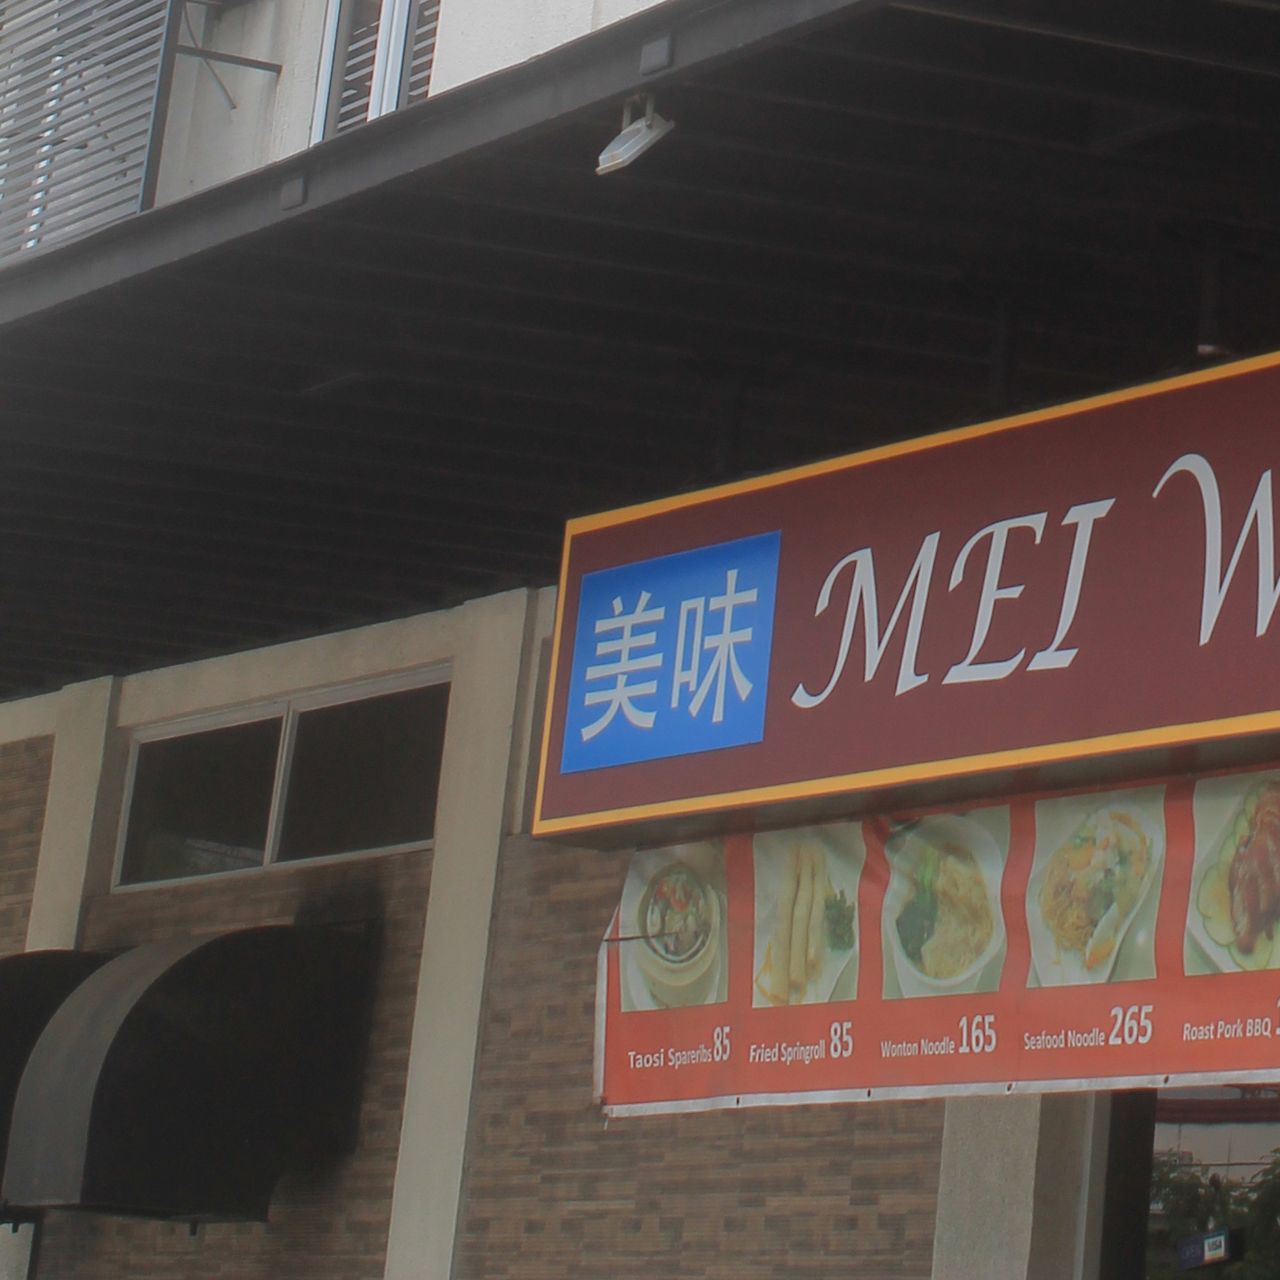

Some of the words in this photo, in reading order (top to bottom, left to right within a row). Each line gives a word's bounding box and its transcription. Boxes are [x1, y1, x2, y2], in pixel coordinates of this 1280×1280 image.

[791, 497, 1116, 710] MEI
[580, 568, 759, 742] 美味
[628, 1048, 664, 1069] Taosi
[667, 1044, 712, 1069] Spareribs
[713, 1026, 731, 1062] 85
[749, 1043, 779, 1063] Fried
[781, 1040, 826, 1065] Springroll
[829, 1021, 853, 1059] 85
[880, 1041, 919, 1059] Wonton
[921, 1036, 955, 1056] Noodle
[958, 1014, 997, 1054] 165
[1023, 1031, 1065, 1051] Seafood
[1067, 1027, 1106, 1048] Noodle
[1108, 1004, 1154, 1046] 265
[1183, 1021, 1216, 1042] Roast
[1217, 1018, 1244, 1040] Pork
[1245, 1015, 1273, 1039] BBQ
